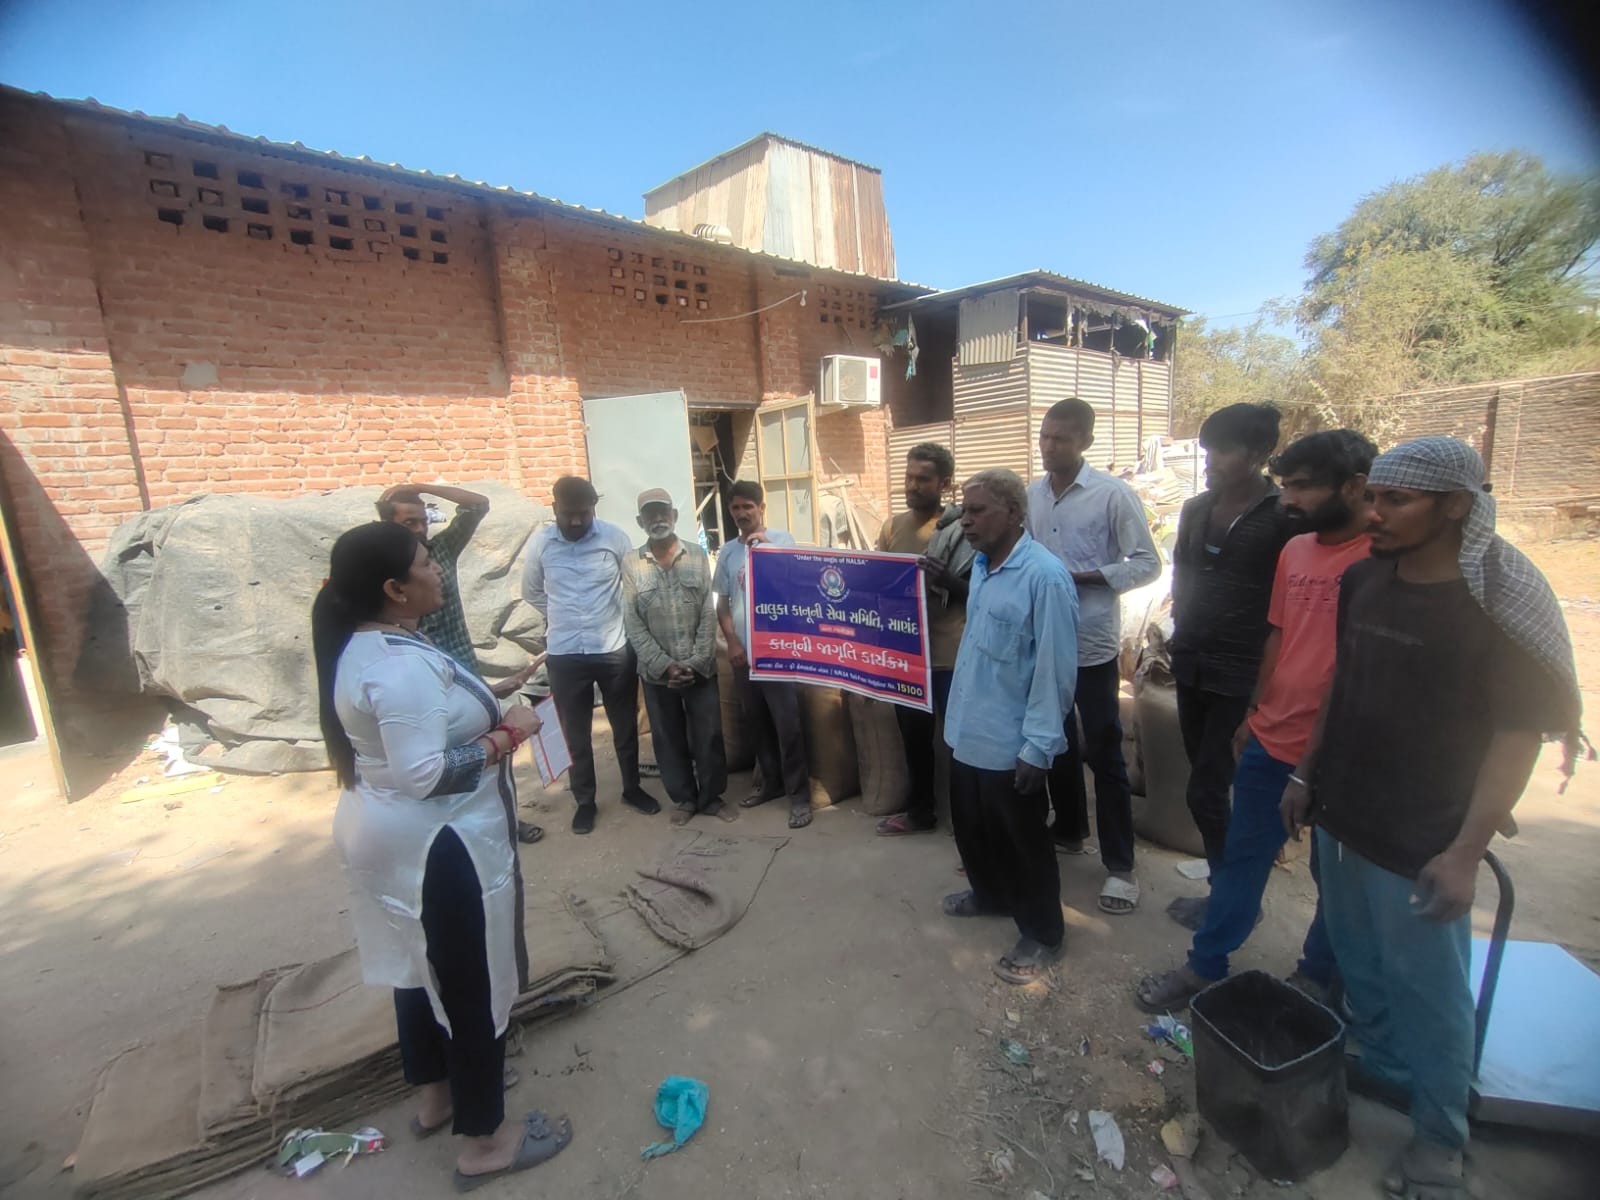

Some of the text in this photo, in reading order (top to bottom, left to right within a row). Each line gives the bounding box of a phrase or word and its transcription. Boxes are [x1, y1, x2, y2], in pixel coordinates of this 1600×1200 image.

[755, 603, 788, 621] તાલુકા
[792, 603, 823, 624] કાનૂની
[826, 604, 846, 622] સેવા
[849, 609, 883, 631] સમિતિ,
[888, 617, 919, 636] સાણંદ
[769, 637, 909, 672] કાનૂની જાગૃતિ કાર્યક્રમ
[897, 682, 923, 697] 15100
